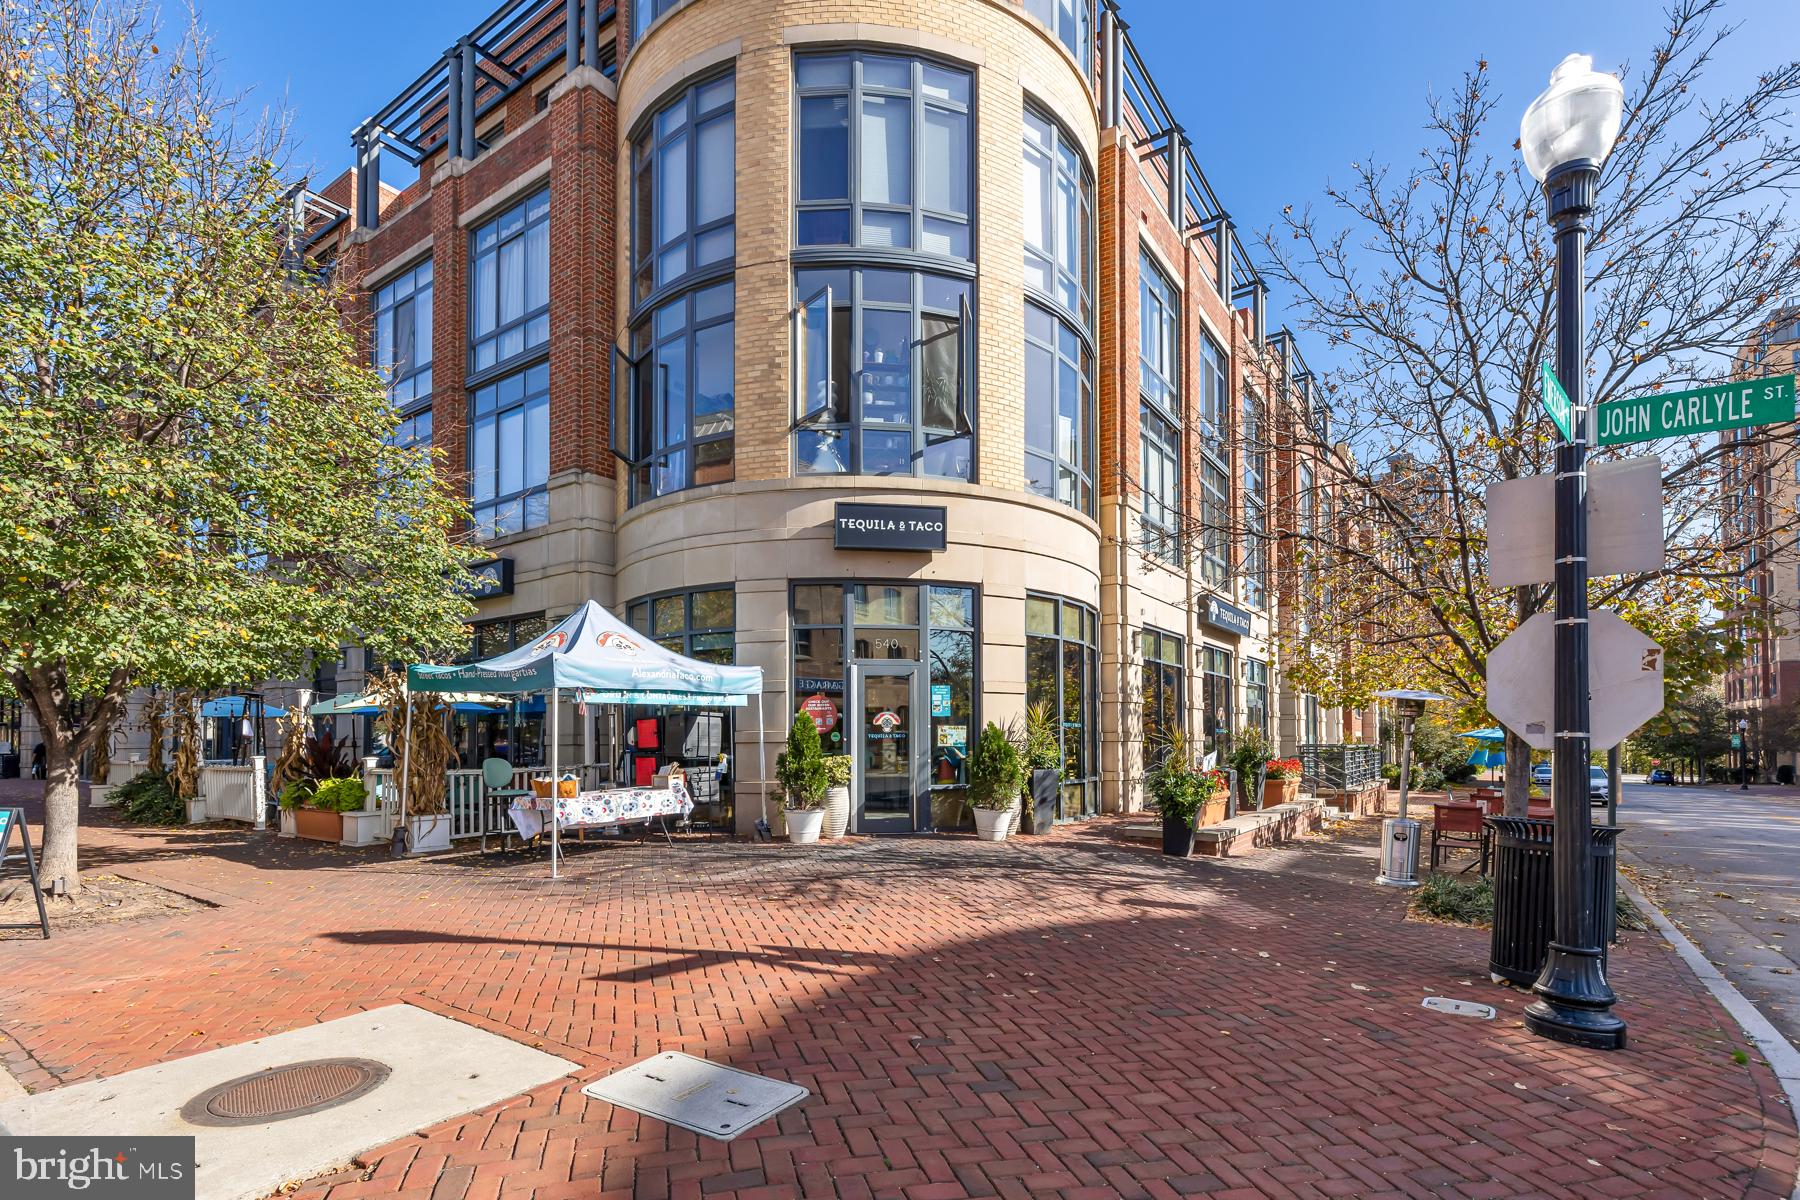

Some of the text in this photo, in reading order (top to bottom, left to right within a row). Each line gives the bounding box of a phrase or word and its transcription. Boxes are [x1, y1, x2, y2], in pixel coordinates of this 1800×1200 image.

[1601, 403, 1650, 437] JOHN
[1661, 389, 1752, 429] CARLYLE
[1763, 385, 1788, 400] ST.
[840, 519, 943, 532] TEQUILA & TACO
[1220, 608, 1236, 625] TEQUILA
[1240, 617, 1249, 629] TACO
[875, 639, 898, 649] 540
[631, 667, 713, 683] AlexandriaTaco.com
